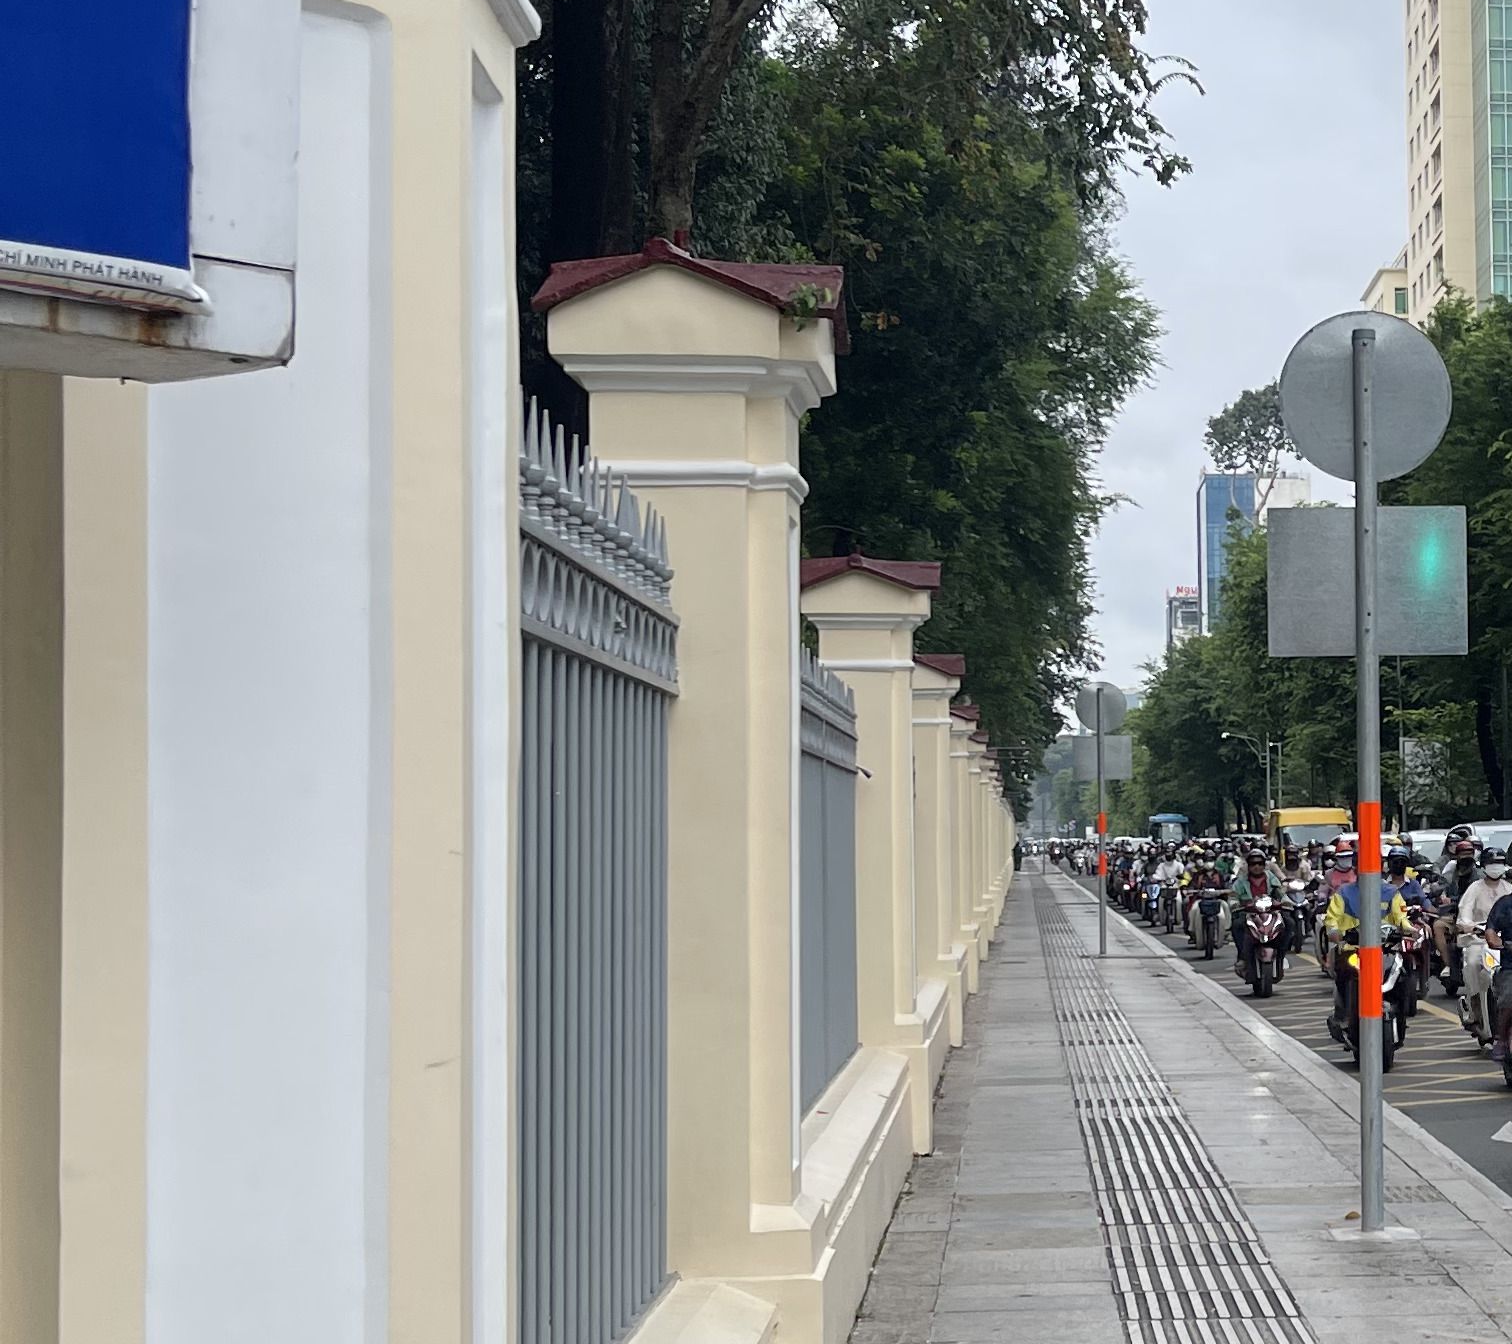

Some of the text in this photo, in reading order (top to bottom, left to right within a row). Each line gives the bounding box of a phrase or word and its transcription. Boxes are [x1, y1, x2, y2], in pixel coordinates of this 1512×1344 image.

[26, 253, 67, 271] MINH
[72, 260, 114, 277] PHÁT
[117, 266, 164, 286] HÀNH
